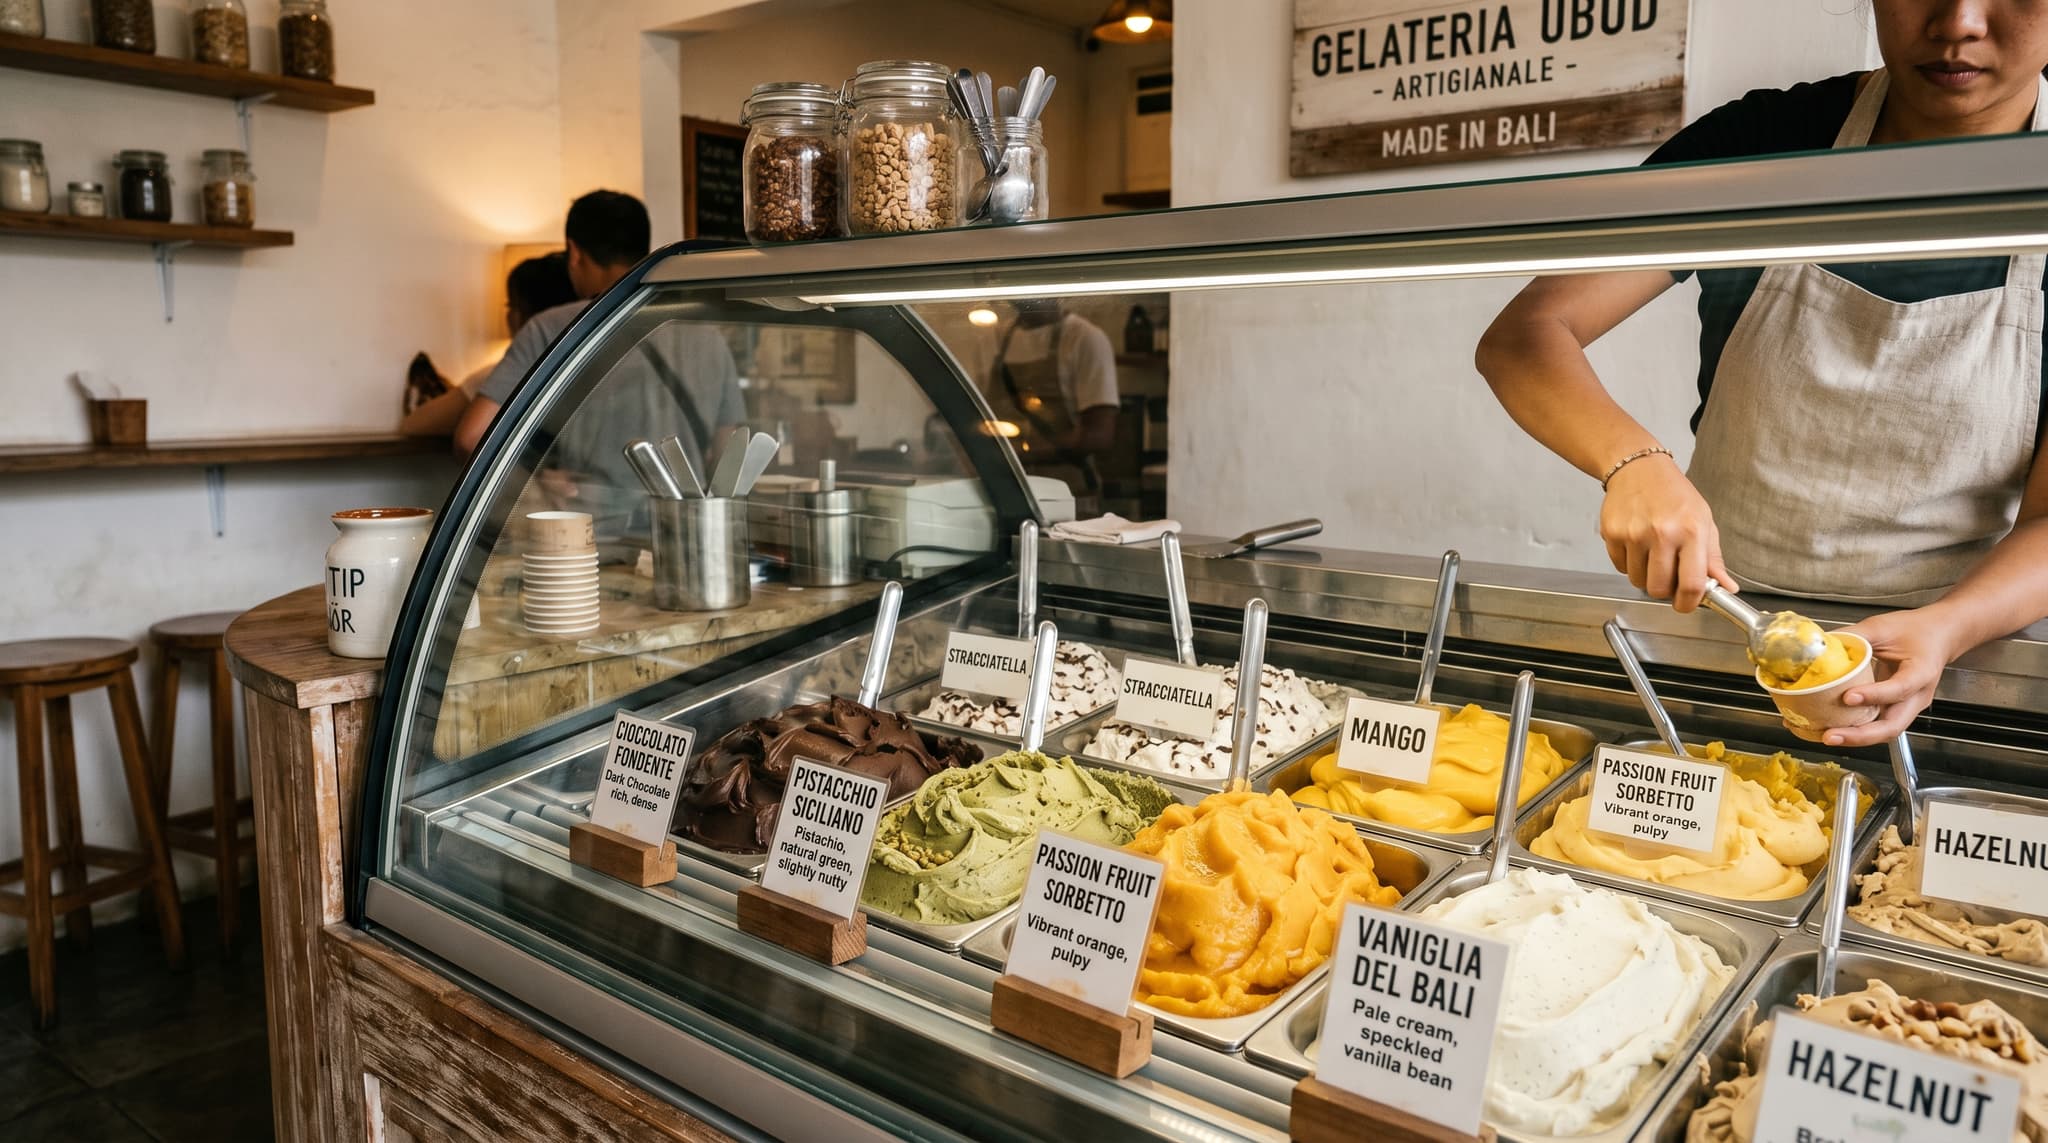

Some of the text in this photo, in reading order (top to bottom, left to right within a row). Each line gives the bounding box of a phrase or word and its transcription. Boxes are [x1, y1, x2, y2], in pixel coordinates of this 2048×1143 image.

[1312, 5, 1517, 77] GELATERIA
[1393, 56, 1555, 101] ARTIGIANALE
[1382, 111, 1557, 158] MADE IN BALI
[328, 566, 365, 598] TIP
[948, 648, 1027, 675] STRACCIATELLA
[1123, 678, 1213, 710] STRACCIATELLA
[616, 721, 687, 757] CIOCCOLATO
[1350, 717, 1426, 753] MANGO
[614, 745, 675, 780] FONDENTE
[1603, 758, 1717, 793] PASSION FRUIT
[605, 769, 671, 800] Dark Chocolate
[611, 788, 658, 812] rich, dense
[794, 766, 878, 809] PISTACCHIO
[1616, 783, 1694, 812] SORBETTO
[792, 795, 864, 835] SICILIANO
[1604, 802, 1701, 832] Vibrant orange,
[1633, 824, 1669, 840] pulpy
[794, 825, 846, 855] Pistachio,
[778, 857, 848, 892] slightly nutty
[780, 841, 853, 876] natural green,
[1036, 843, 1156, 898] PASSION FRUIT
[1044, 878, 1126, 924] SORBETTO
[1028, 913, 1128, 963] Vibrant orange,
[1359, 916, 1482, 980] VANIGLIA
[1051, 946, 1091, 971] pulpy
[1352, 955, 1475, 1019] DEL BALI
[1353, 998, 1458, 1048] Pale cream,
[1360, 1027, 1443, 1064] speckled
[1344, 1043, 1453, 1091] vanilla bean
[1788, 1039, 1993, 1133] HAZELNUT
